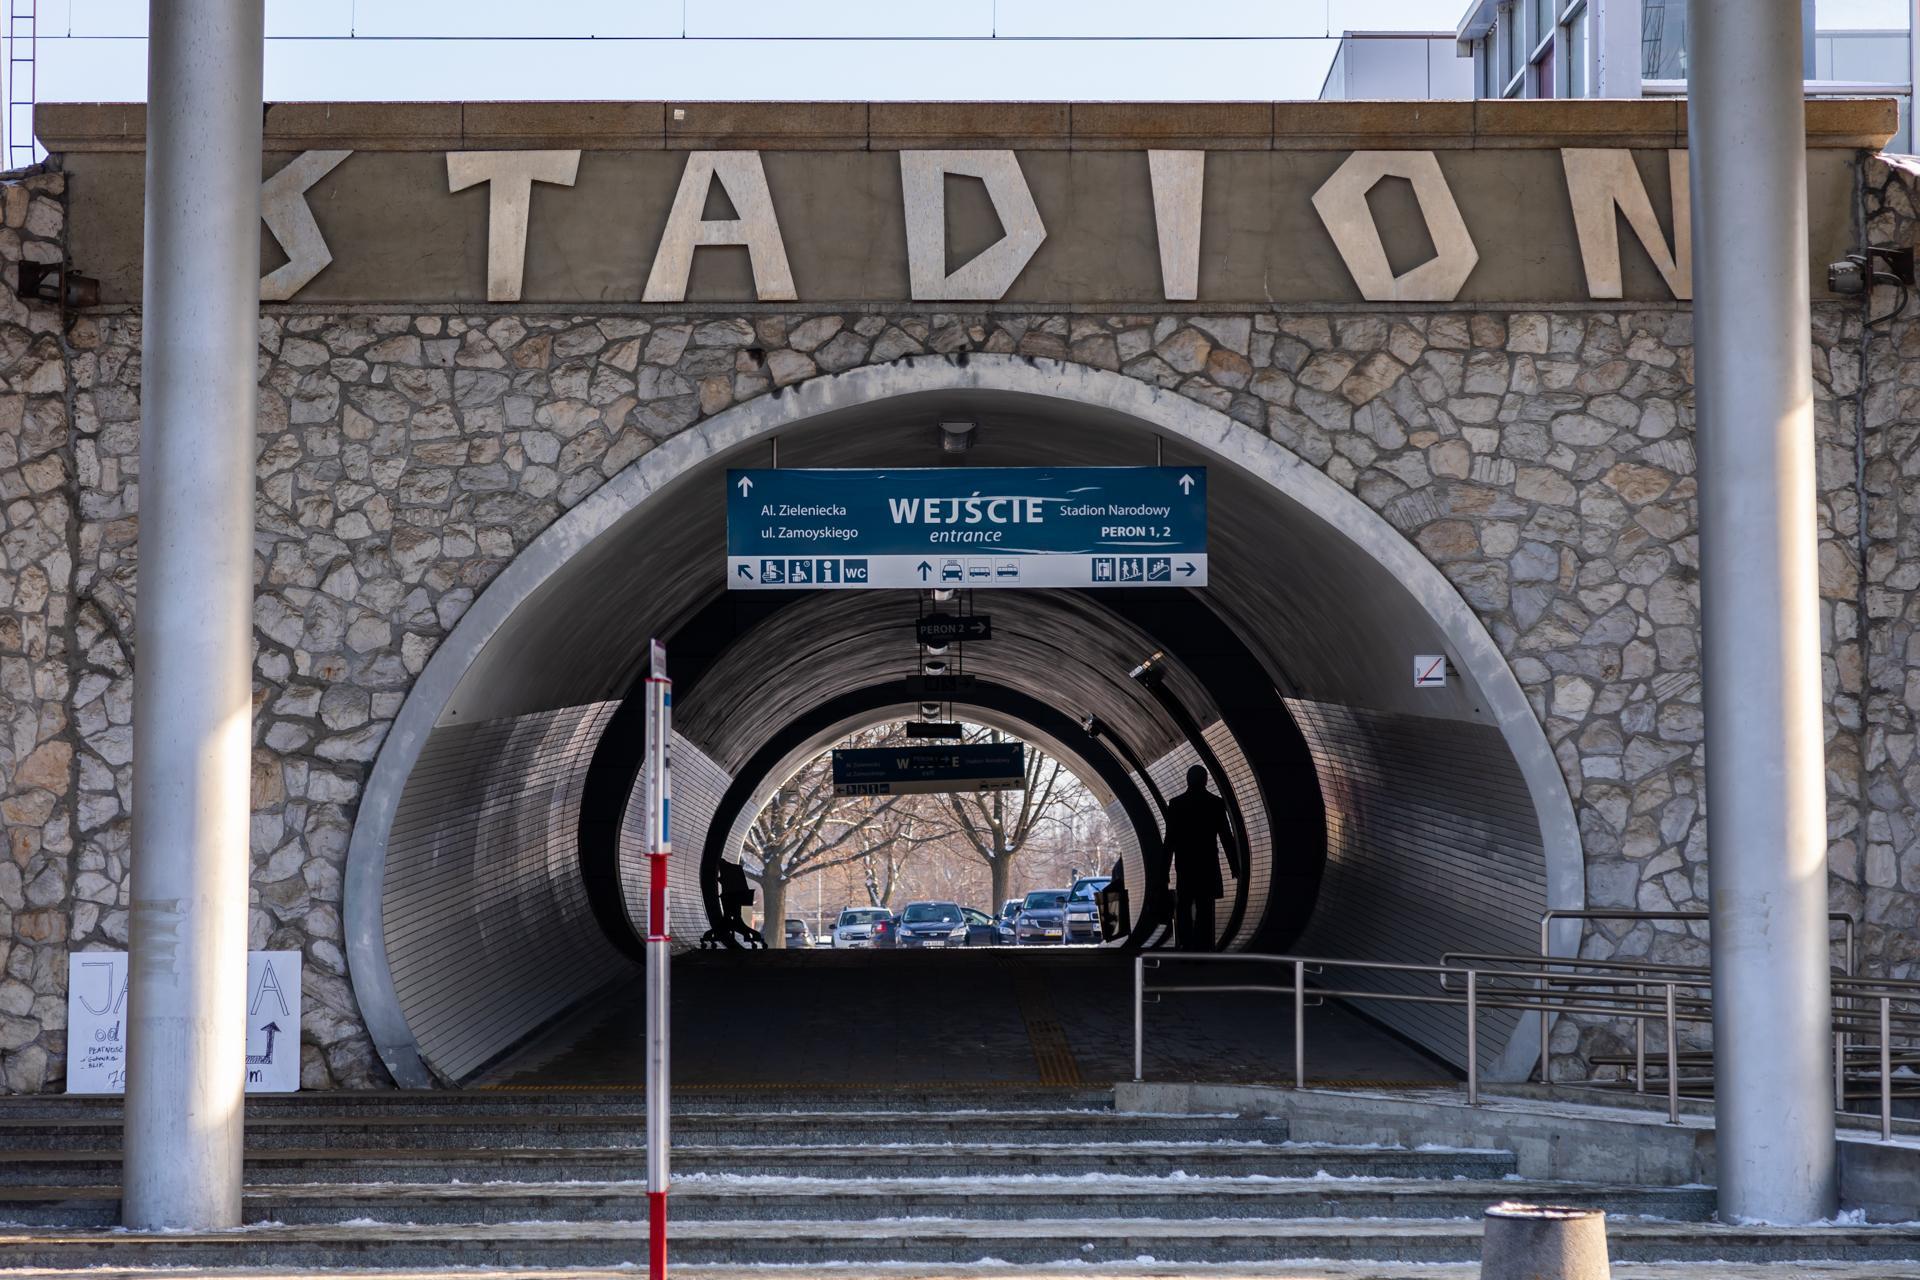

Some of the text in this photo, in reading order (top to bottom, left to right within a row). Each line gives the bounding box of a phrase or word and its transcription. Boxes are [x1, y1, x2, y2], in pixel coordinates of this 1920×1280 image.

[260, 149, 1692, 300] STADION
[761, 504, 847, 516] Al. Zieleniecka
[888, 491, 1044, 524] WEJŚCIE
[1060, 504, 1170, 518] Stadion Narodowy
[761, 526, 858, 541] ul. Zamoyskiego
[929, 529, 1002, 543] entrance
[1101, 526, 1171, 538] PERON 1, 2
[845, 568, 866, 579] WC
[920, 623, 965, 635] PERON 2
[95, 1020, 120, 1042] od
